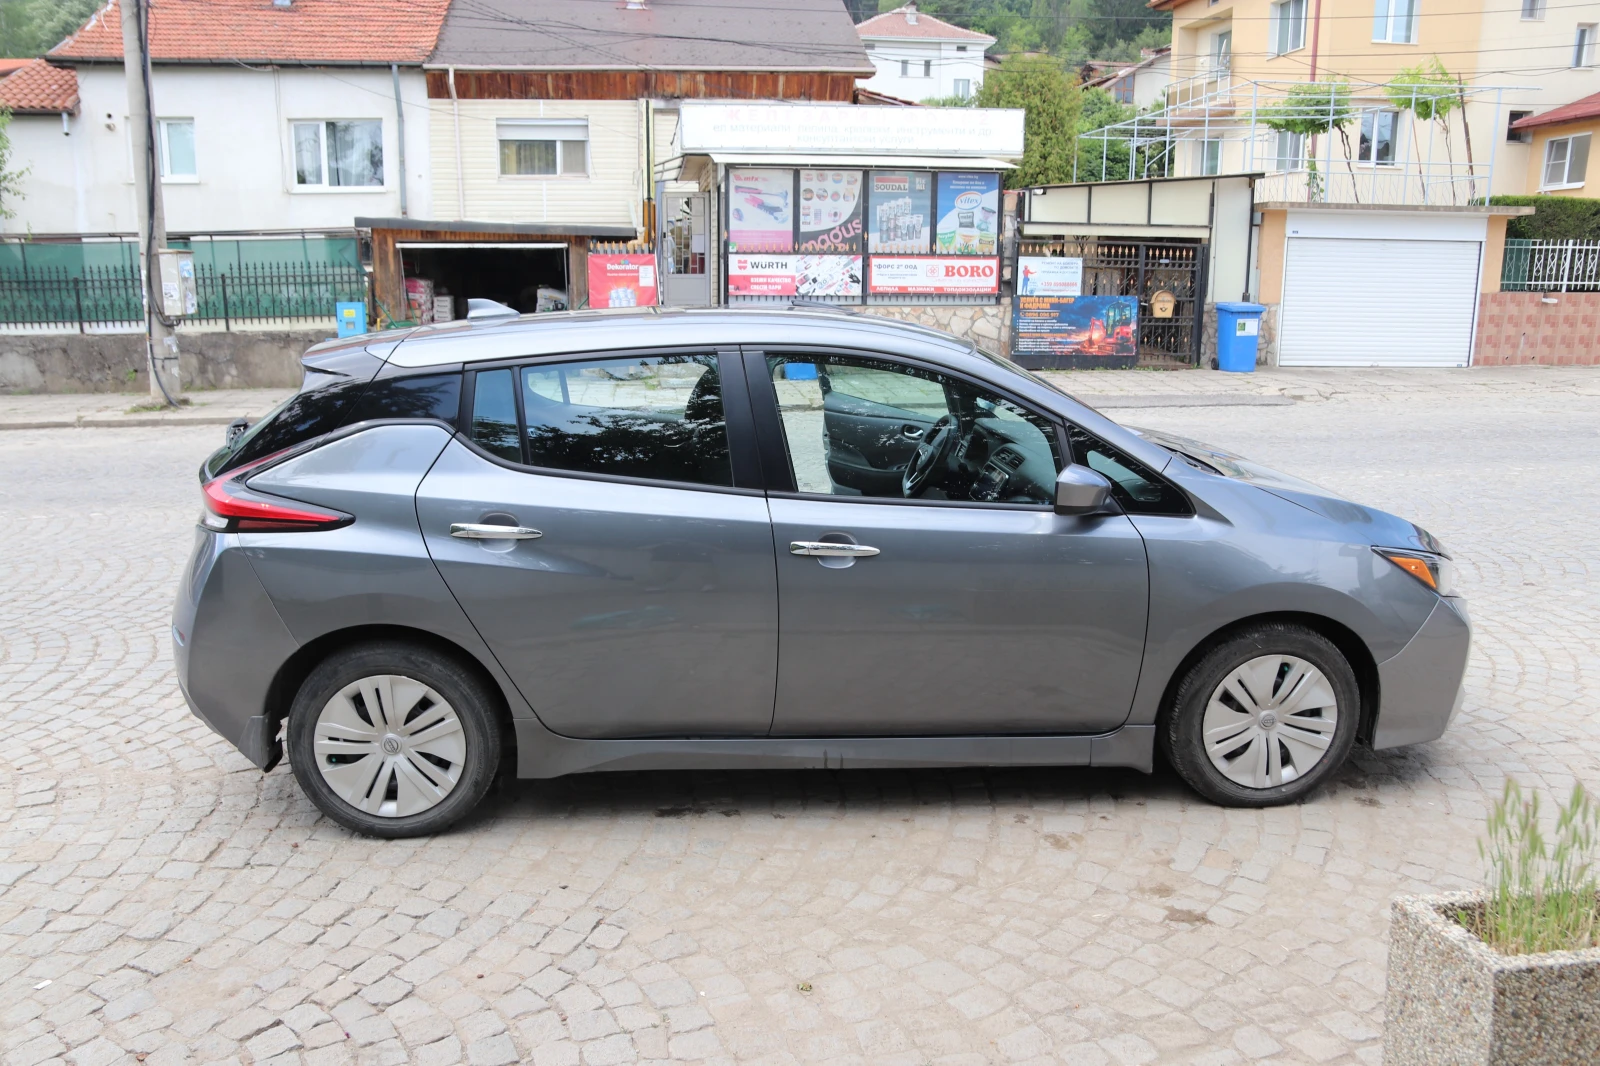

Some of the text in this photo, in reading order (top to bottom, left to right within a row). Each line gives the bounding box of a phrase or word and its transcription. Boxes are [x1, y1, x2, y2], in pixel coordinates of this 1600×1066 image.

[978, 111, 990, 126] 2
[874, 183, 908, 192] SOUDAL
[943, 265, 994, 277] BORO
